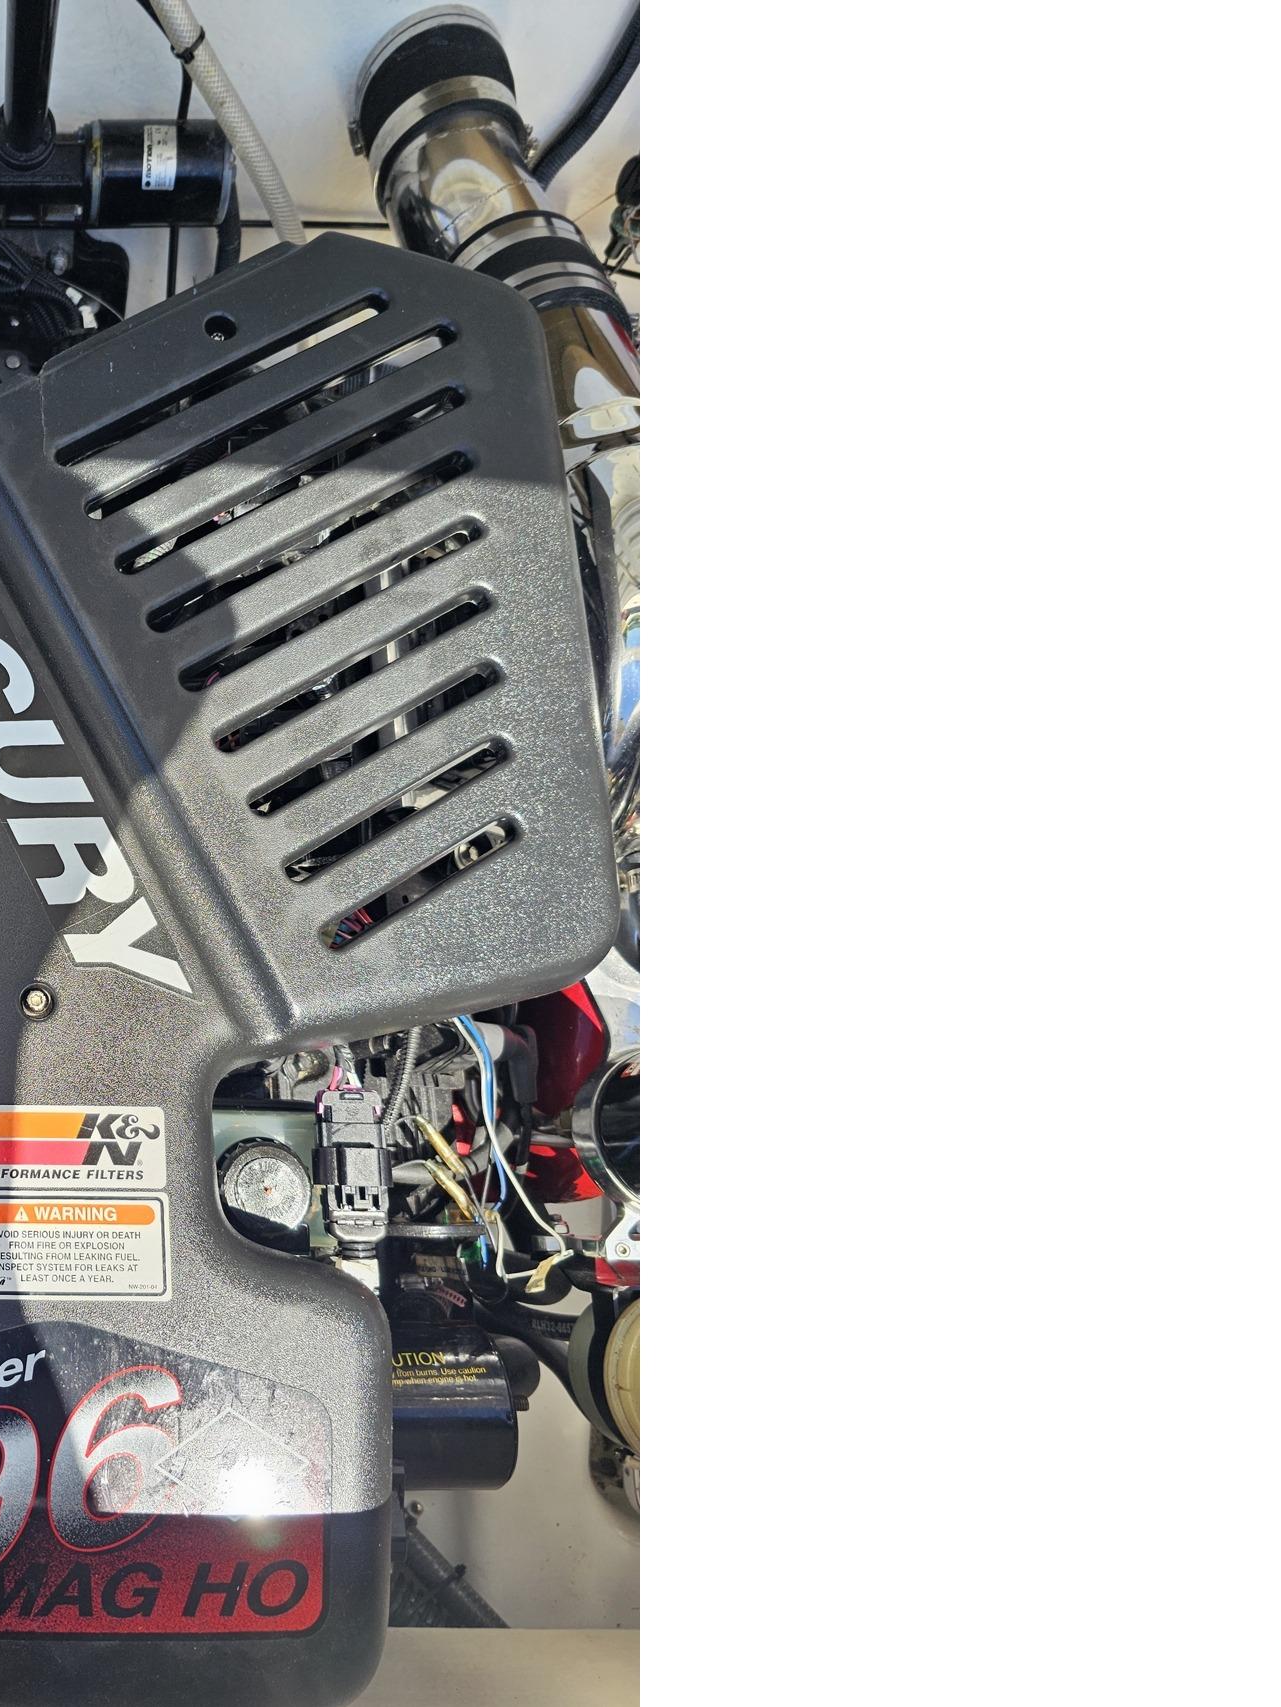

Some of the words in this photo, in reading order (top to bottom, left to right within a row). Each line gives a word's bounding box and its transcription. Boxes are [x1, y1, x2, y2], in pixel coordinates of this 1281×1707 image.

[87, 1169, 144, 1180] FILTERS
[34, 1206, 117, 1221] WARNING
[22, 1230, 61, 1239] SERIOUS
[62, 1231, 94, 1239] INJURY
[96, 1231, 110, 1239] OR
[112, 1231, 141, 1239] DEATH
[8, 1241, 34, 1250] FROM
[36, 1241, 56, 1250] FIRE
[59, 1242, 72, 1250] OR
[74, 1242, 125, 1250] EXPLOSION
[45, 1252, 71, 1261] FROM
[73, 1253, 113, 1261] LEAKING
[115, 1253, 141, 1262] FUEL.
[36, 1263, 72, 1271] SYSTEM
[74, 1264, 94, 1272] FOR
[95, 1264, 125, 1272] LEAKS
[127, 1264, 138, 1272] AT
[20, 1274, 50, 1282] LEAST
[51, 1274, 77, 1283] ONCE
[79, 1275, 86, 1283] A
[88, 1275, 114, 1283] YEAR.
[392, 1351, 446, 1367] UTION
[397, 1368, 415, 1377] from
[441, 1367, 457, 1375] Use
[458, 1366, 487, 1374] caution
[169, 1560, 310, 1617] HO
